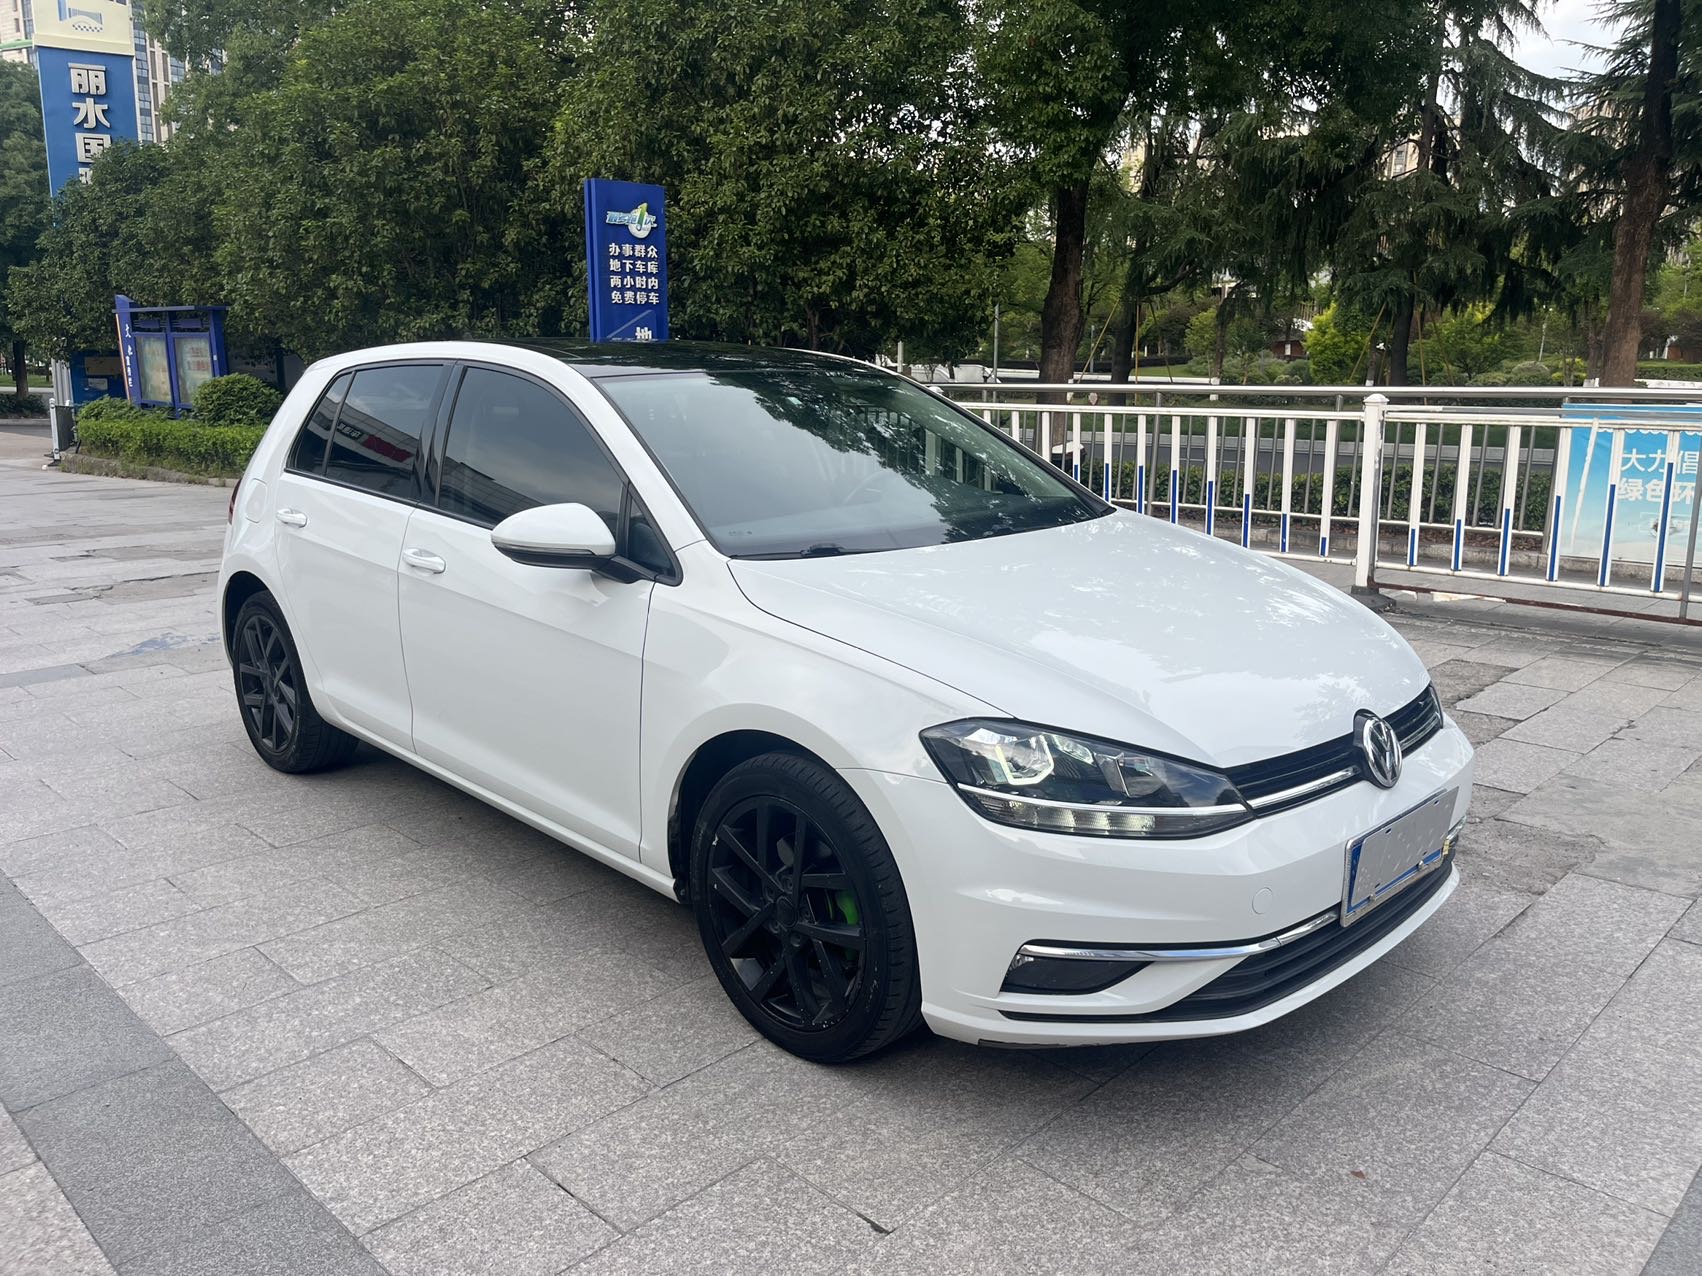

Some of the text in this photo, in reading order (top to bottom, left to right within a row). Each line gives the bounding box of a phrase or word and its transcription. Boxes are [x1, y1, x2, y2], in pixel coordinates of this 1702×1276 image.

[68, 62, 112, 185] 丽水国
[608, 243, 658, 258] 办事群众
[609, 259, 659, 274] 地下车库
[610, 275, 659, 290] 两小时内
[611, 291, 660, 305] 免费停车
